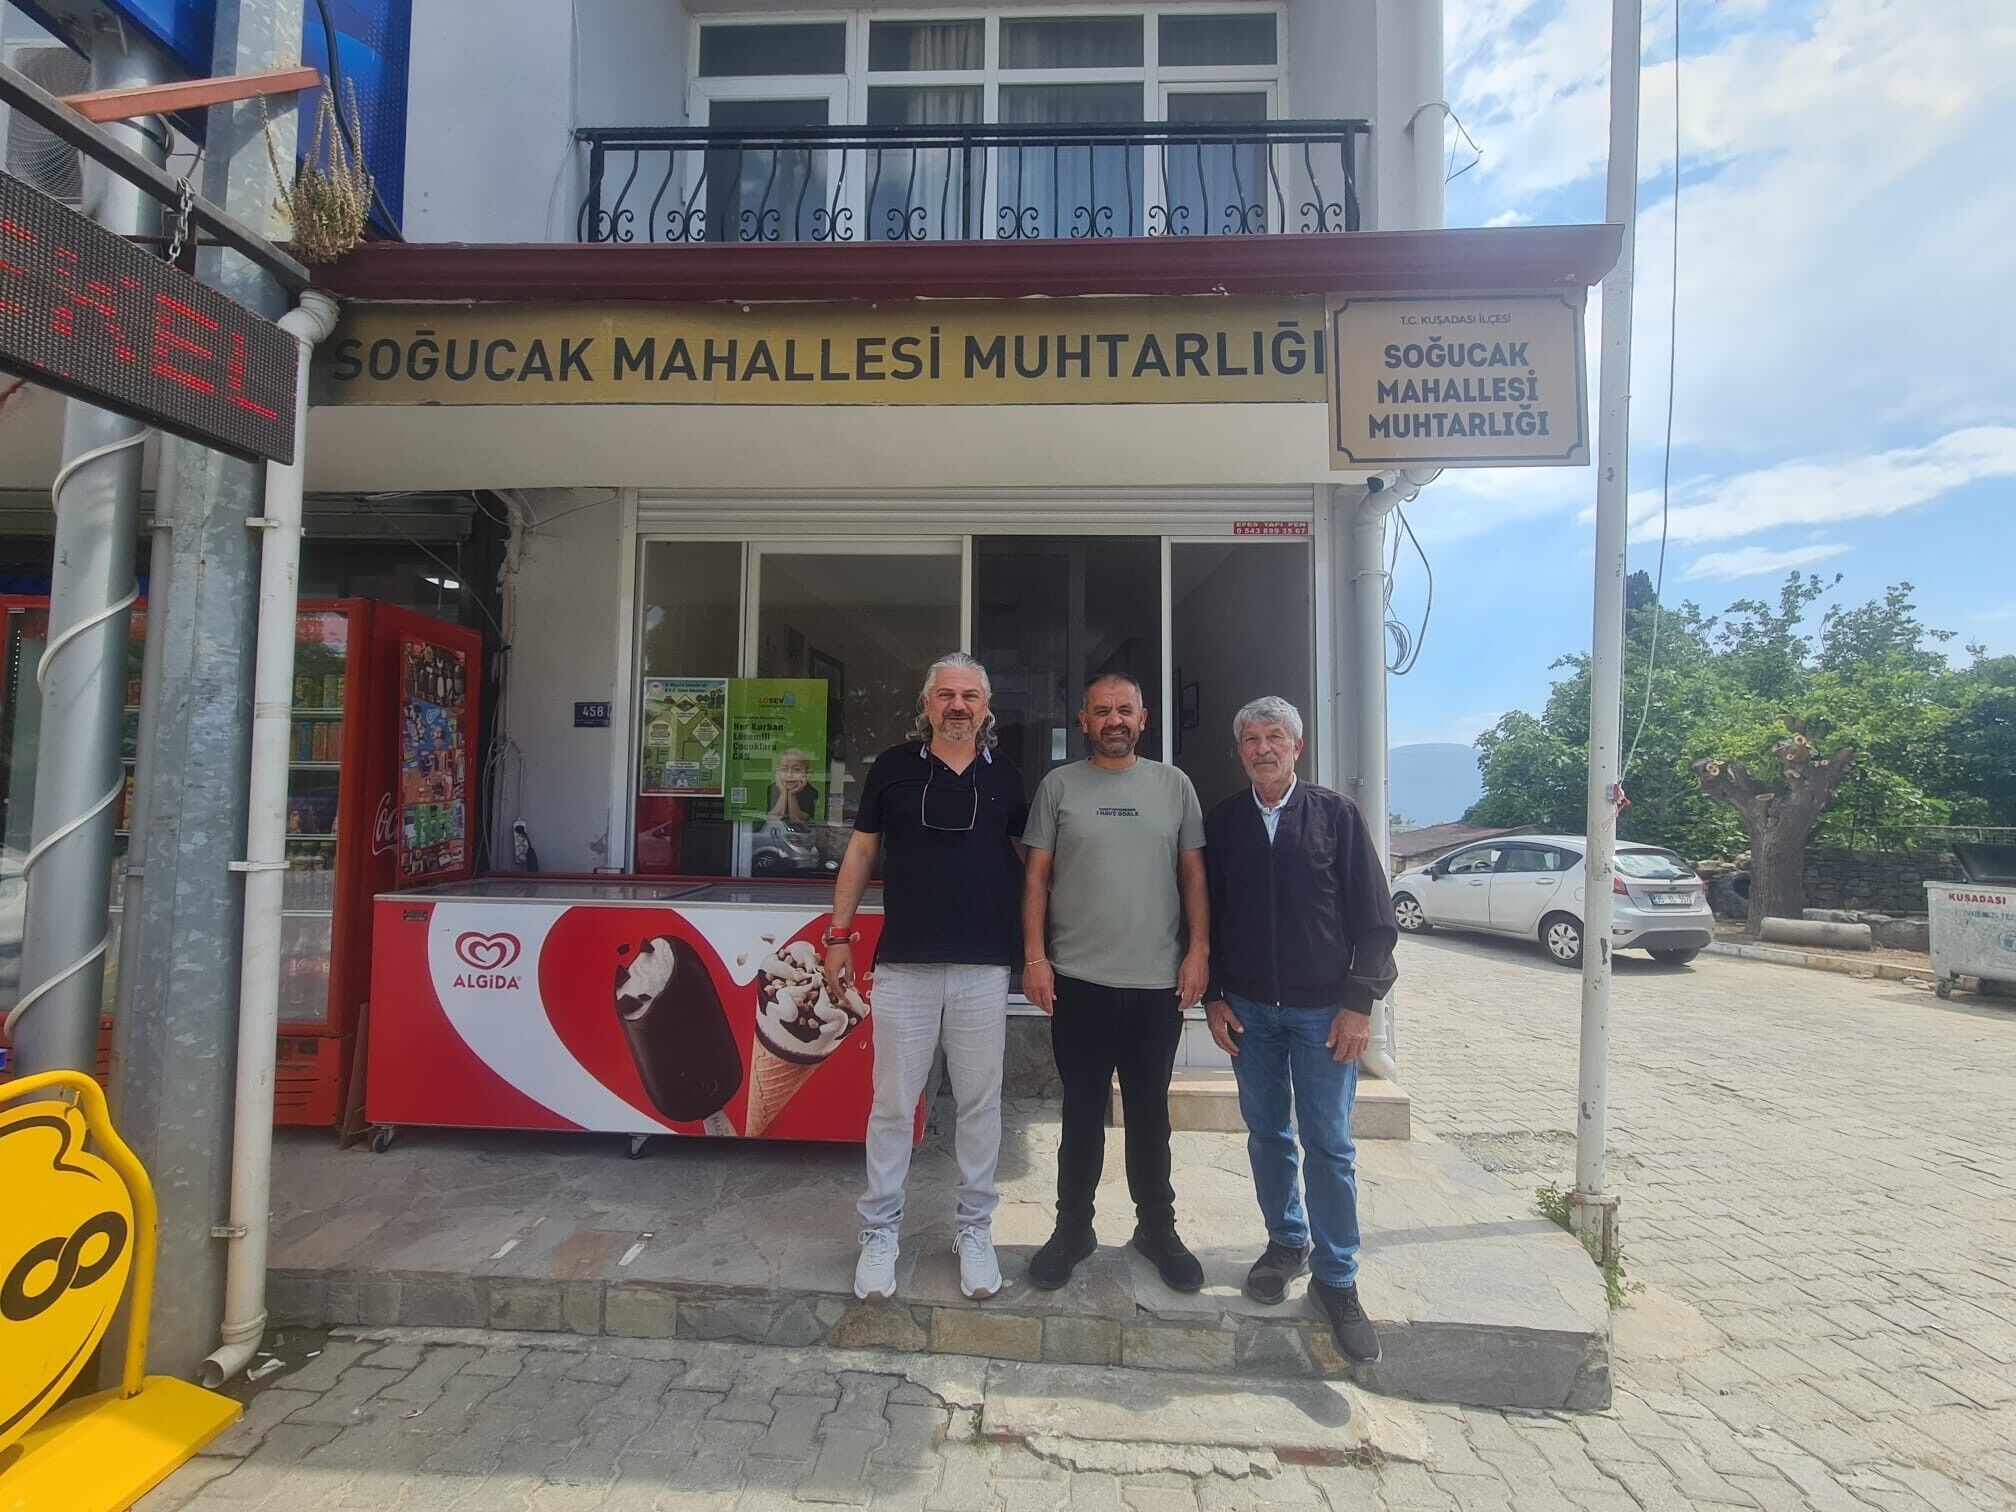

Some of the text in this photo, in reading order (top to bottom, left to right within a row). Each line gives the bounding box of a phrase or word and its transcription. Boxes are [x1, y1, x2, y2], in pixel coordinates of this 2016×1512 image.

[1421, 314, 1476, 327] KUŞADASI
[1479, 312, 1512, 326] İLÇESİ
[331, 320, 1325, 382] SOĞUCAK MAHALLESİ MUHTARLIĞI
[1384, 335, 1530, 369] SOĞUCAK
[1377, 369, 1539, 404] MAHALLESİ
[1368, 403, 1550, 439] MUHTARLIĞI
[582, 705, 604, 717] 458
[758, 695, 785, 704] LÖSEV
[751, 722, 784, 731] Kurban
